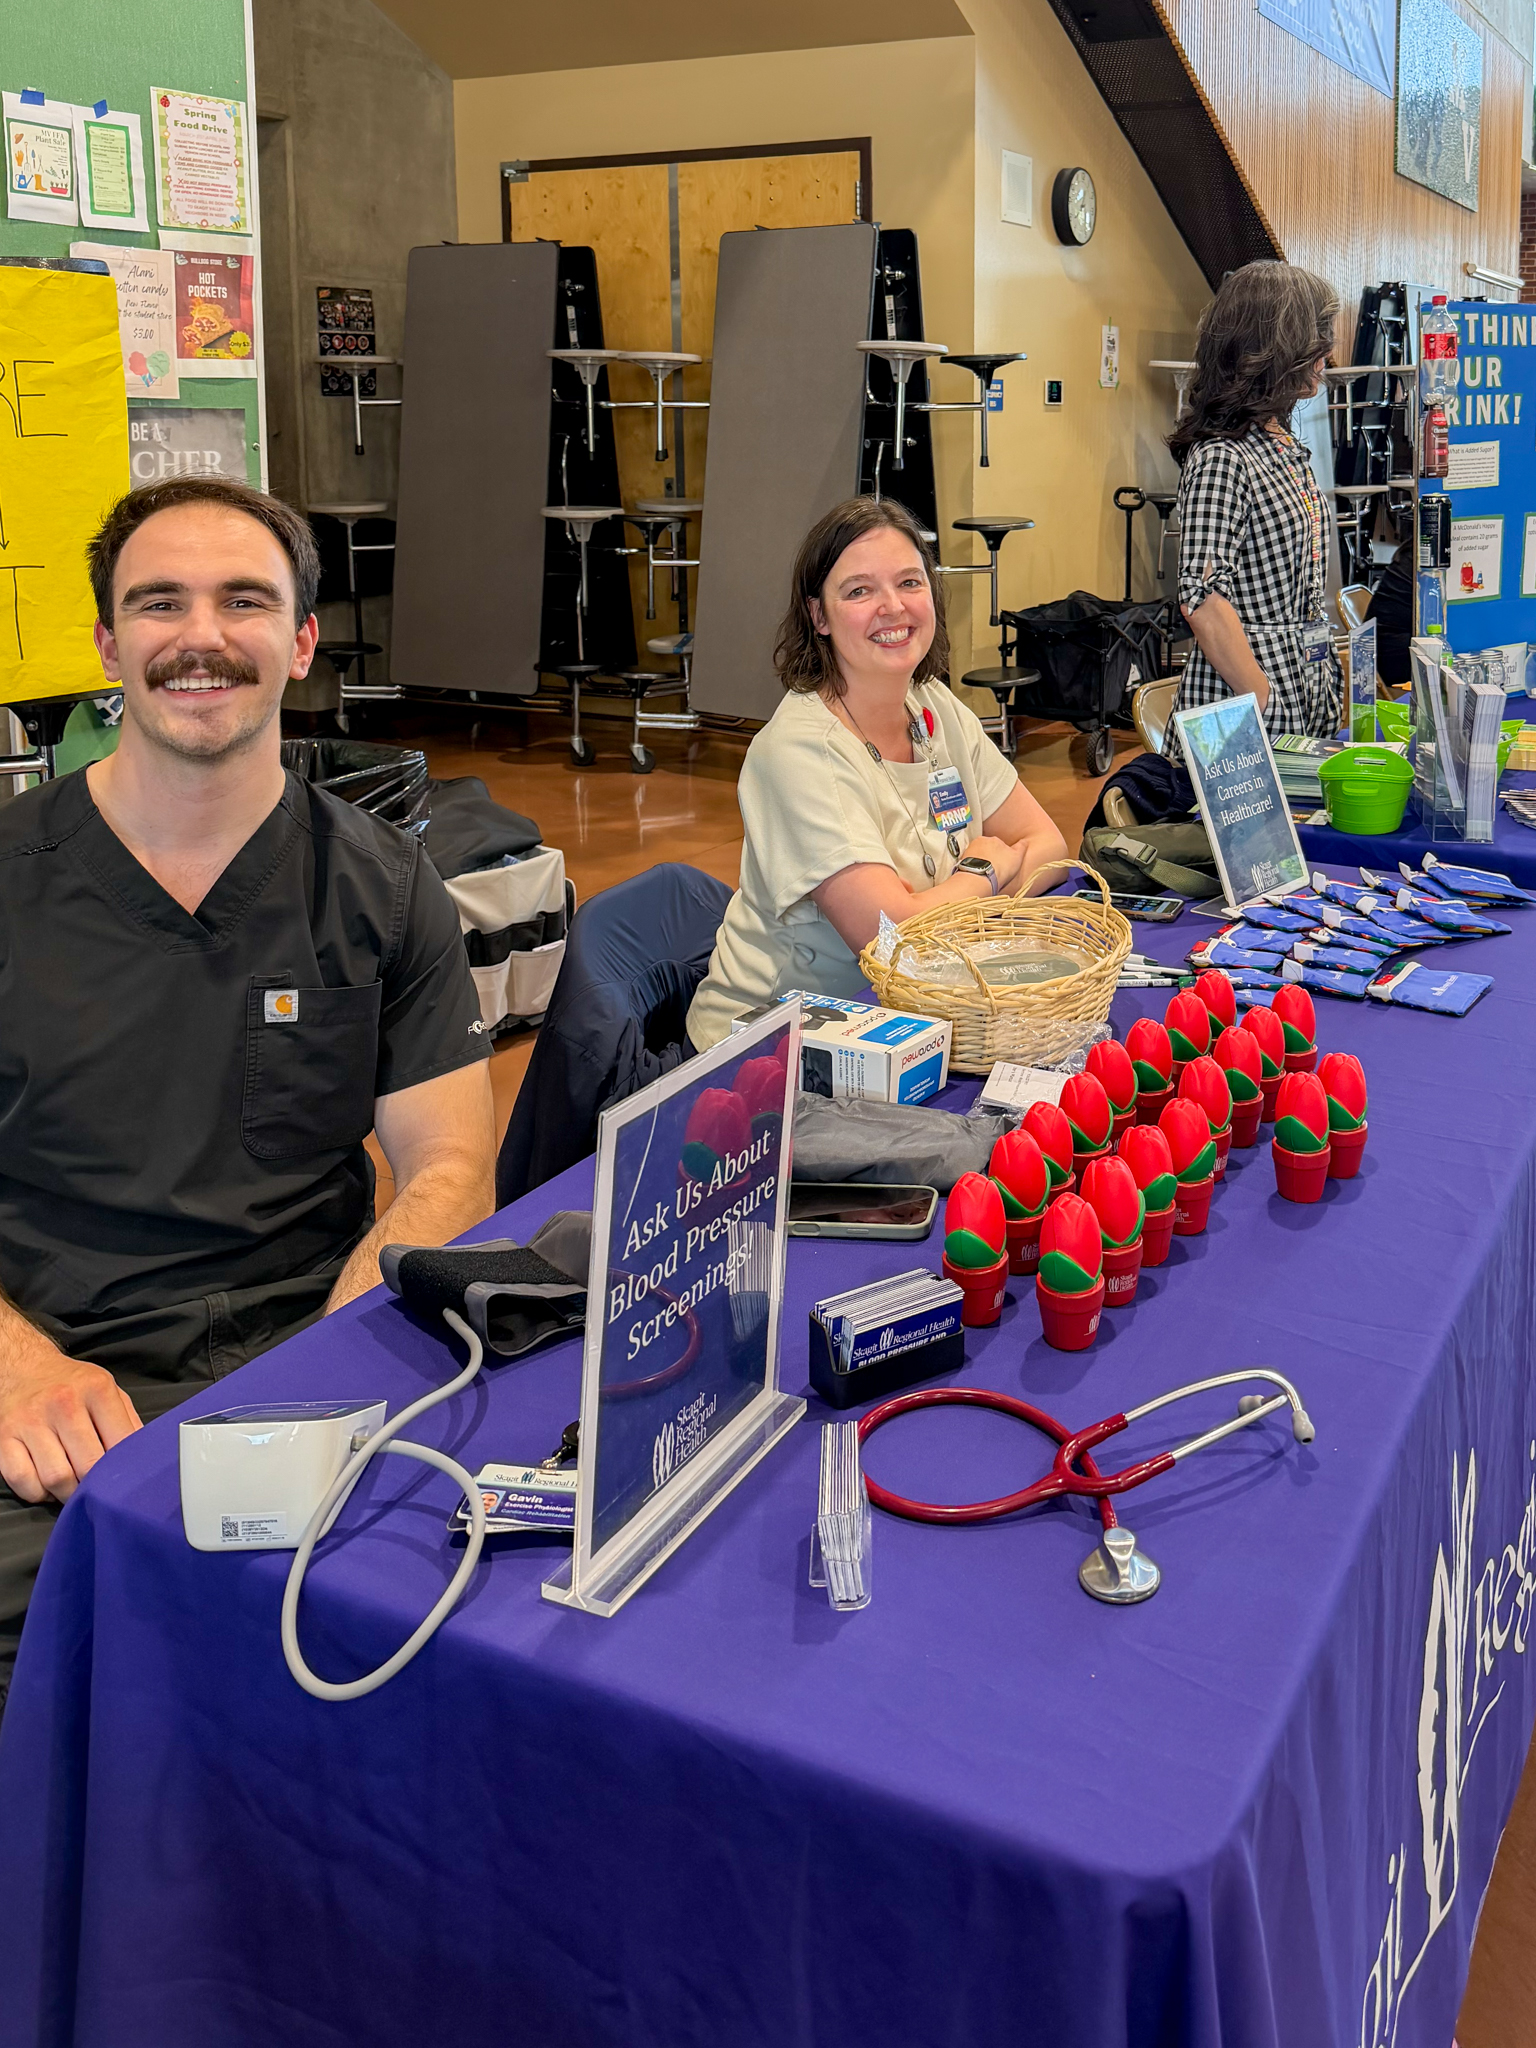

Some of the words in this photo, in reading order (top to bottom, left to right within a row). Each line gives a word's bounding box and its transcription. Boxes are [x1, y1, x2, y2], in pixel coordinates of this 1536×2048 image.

[184, 108, 216, 122] Spring
[174, 120, 199, 130] Food
[202, 124, 228, 134] Drive
[36, 136, 52, 144] Plant
[53, 138, 66, 146] Sale
[190, 257, 209, 265] BULLDOG
[127, 264, 155, 279] Alani
[199, 272, 215, 285] HOT
[142, 284, 169, 296] candy
[188, 285, 228, 298] POCKETS
[123, 309, 132, 317] the
[134, 310, 155, 319] student
[157, 312, 172, 320] store
[133, 328, 154, 339] $3.00
[131, 422, 149, 442] BE
[1465, 446, 1479, 454] Added
[1480, 446, 1495, 455] Sugar?
[1204, 764, 1223, 780] Ask
[1222, 757, 1236, 773] Us
[1237, 749, 1265, 769] About
[1217, 780, 1253, 801] Careers
[1252, 775, 1265, 788] in
[940, 808, 968, 828] ARNP
[1220, 795, 1274, 827] Healthcare!
[902, 1037, 936, 1069] paramed
[621, 1202, 670, 1261] Ask
[674, 1180, 703, 1219] Us
[706, 1129, 772, 1197] About
[608, 1239, 678, 1324] Blood
[684, 1175, 776, 1263] Pressure
[627, 1230, 754, 1361] Screenings!
[852, 1342, 878, 1359] Skagit
[893, 1325, 928, 1344] Regional
[929, 1316, 956, 1332] Health
[676, 1390, 706, 1428] Skagit
[676, 1394, 716, 1442] Regional
[674, 1424, 707, 1467] Health
[494, 1474, 519, 1482] Skagit
[534, 1478, 570, 1487] Regional
[508, 1494, 543, 1504] Gavin
[526, 1510, 571, 1518] Rehabilitation
[534, 1504, 573, 1513] Physiologist
